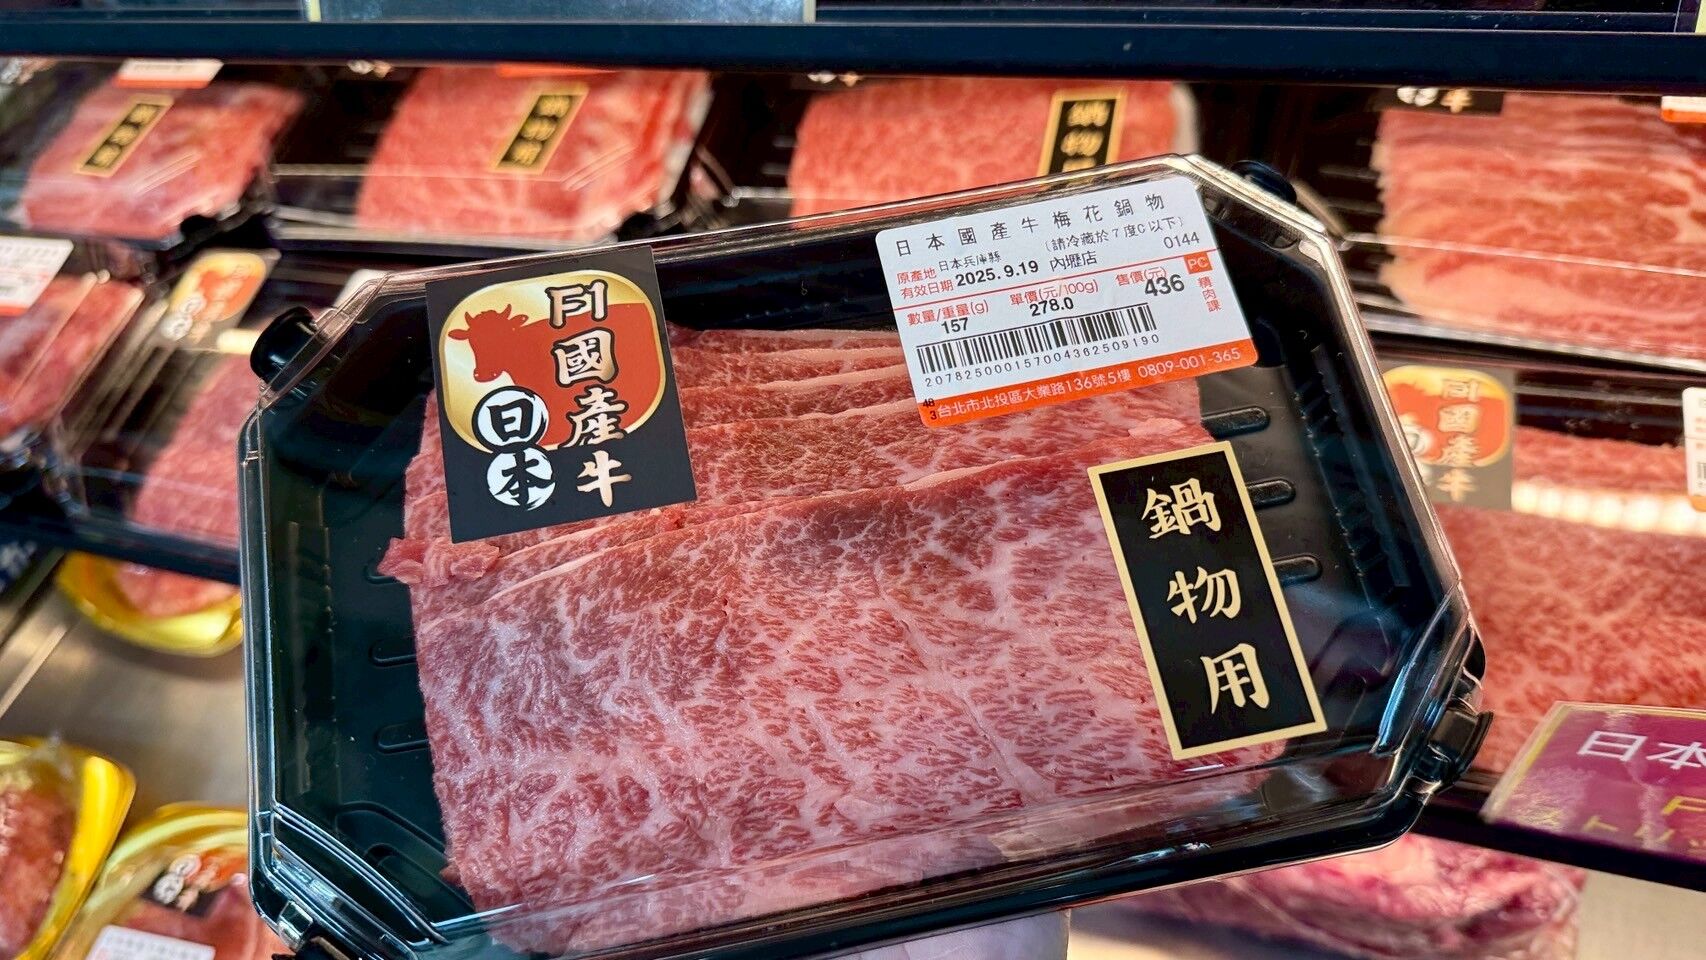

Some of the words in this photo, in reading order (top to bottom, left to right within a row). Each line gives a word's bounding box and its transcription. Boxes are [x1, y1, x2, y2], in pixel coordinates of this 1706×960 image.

[896, 194, 1165, 257] 日本國產牛梅花鍋物
[1164, 231, 1200, 249] 0144
[1187, 256, 1208, 272] PC
[901, 280, 955, 299] 有效日期
[1144, 274, 1185, 297] 436
[1029, 297, 1074, 317] 278.0
[941, 317, 969, 335] 157
[938, 368, 1132, 419] 台北市北投區大業路136號5樓
[1137, 347, 1241, 379] 0809-001-365
[930, 410, 938, 421] 3
[486, 397, 556, 507] 日本
[1141, 477, 1270, 714] 鍋物用
